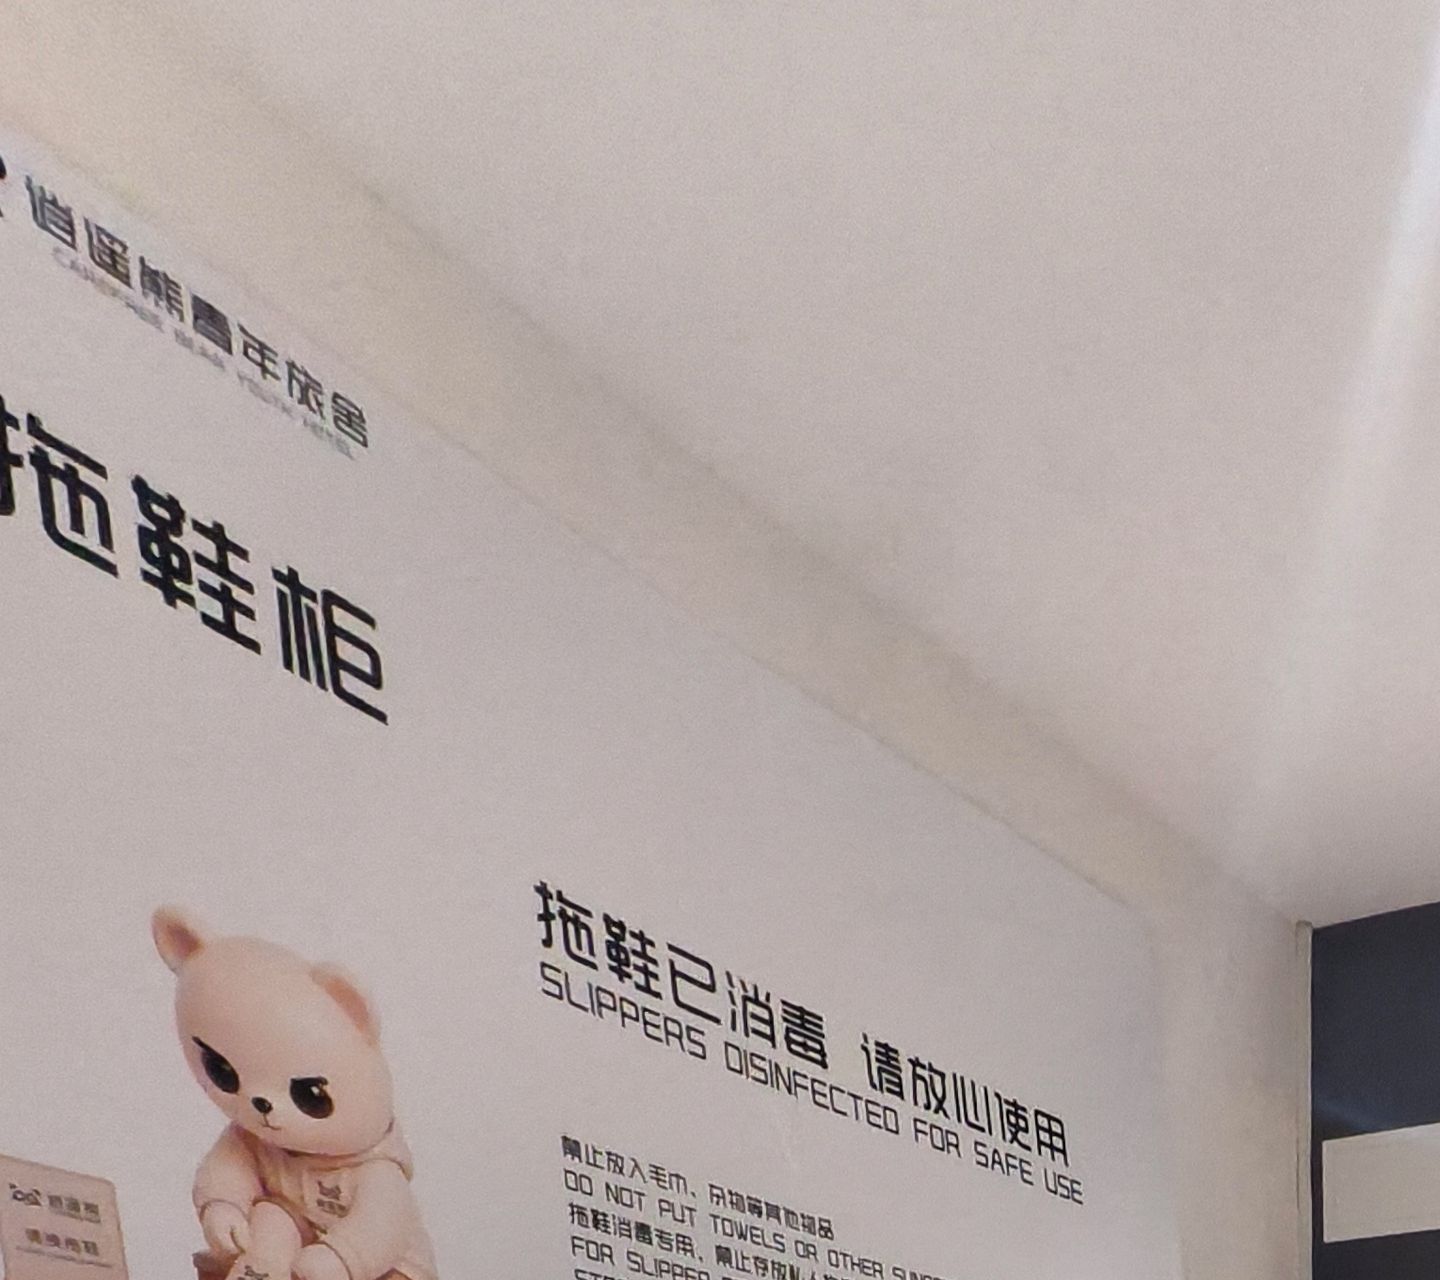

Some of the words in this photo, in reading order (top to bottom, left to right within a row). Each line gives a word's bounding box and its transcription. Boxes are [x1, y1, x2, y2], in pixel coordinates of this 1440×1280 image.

[0, 394, 389, 726] 拖鞋柜
[534, 880, 829, 1069] 拖鞋已消毒
[861, 1032, 1069, 1167] 请放心使用
[540, 961, 707, 1060] SLIPPERS
[724, 1041, 899, 1135] DISINFECTED
[913, 1117, 962, 1158] FOR
[973, 1140, 1034, 1186] SAFE
[1044, 1167, 1083, 1205] USE
[563, 1168, 593, 1197] DO
[605, 1181, 646, 1212] NOT
[658, 1198, 697, 1227] PUT
[708, 1213, 786, 1252] TOWELS
[794, 1239, 819, 1262] OR
[827, 1249, 884, 1280] OTHER
[571, 1236, 615, 1266] FOR
